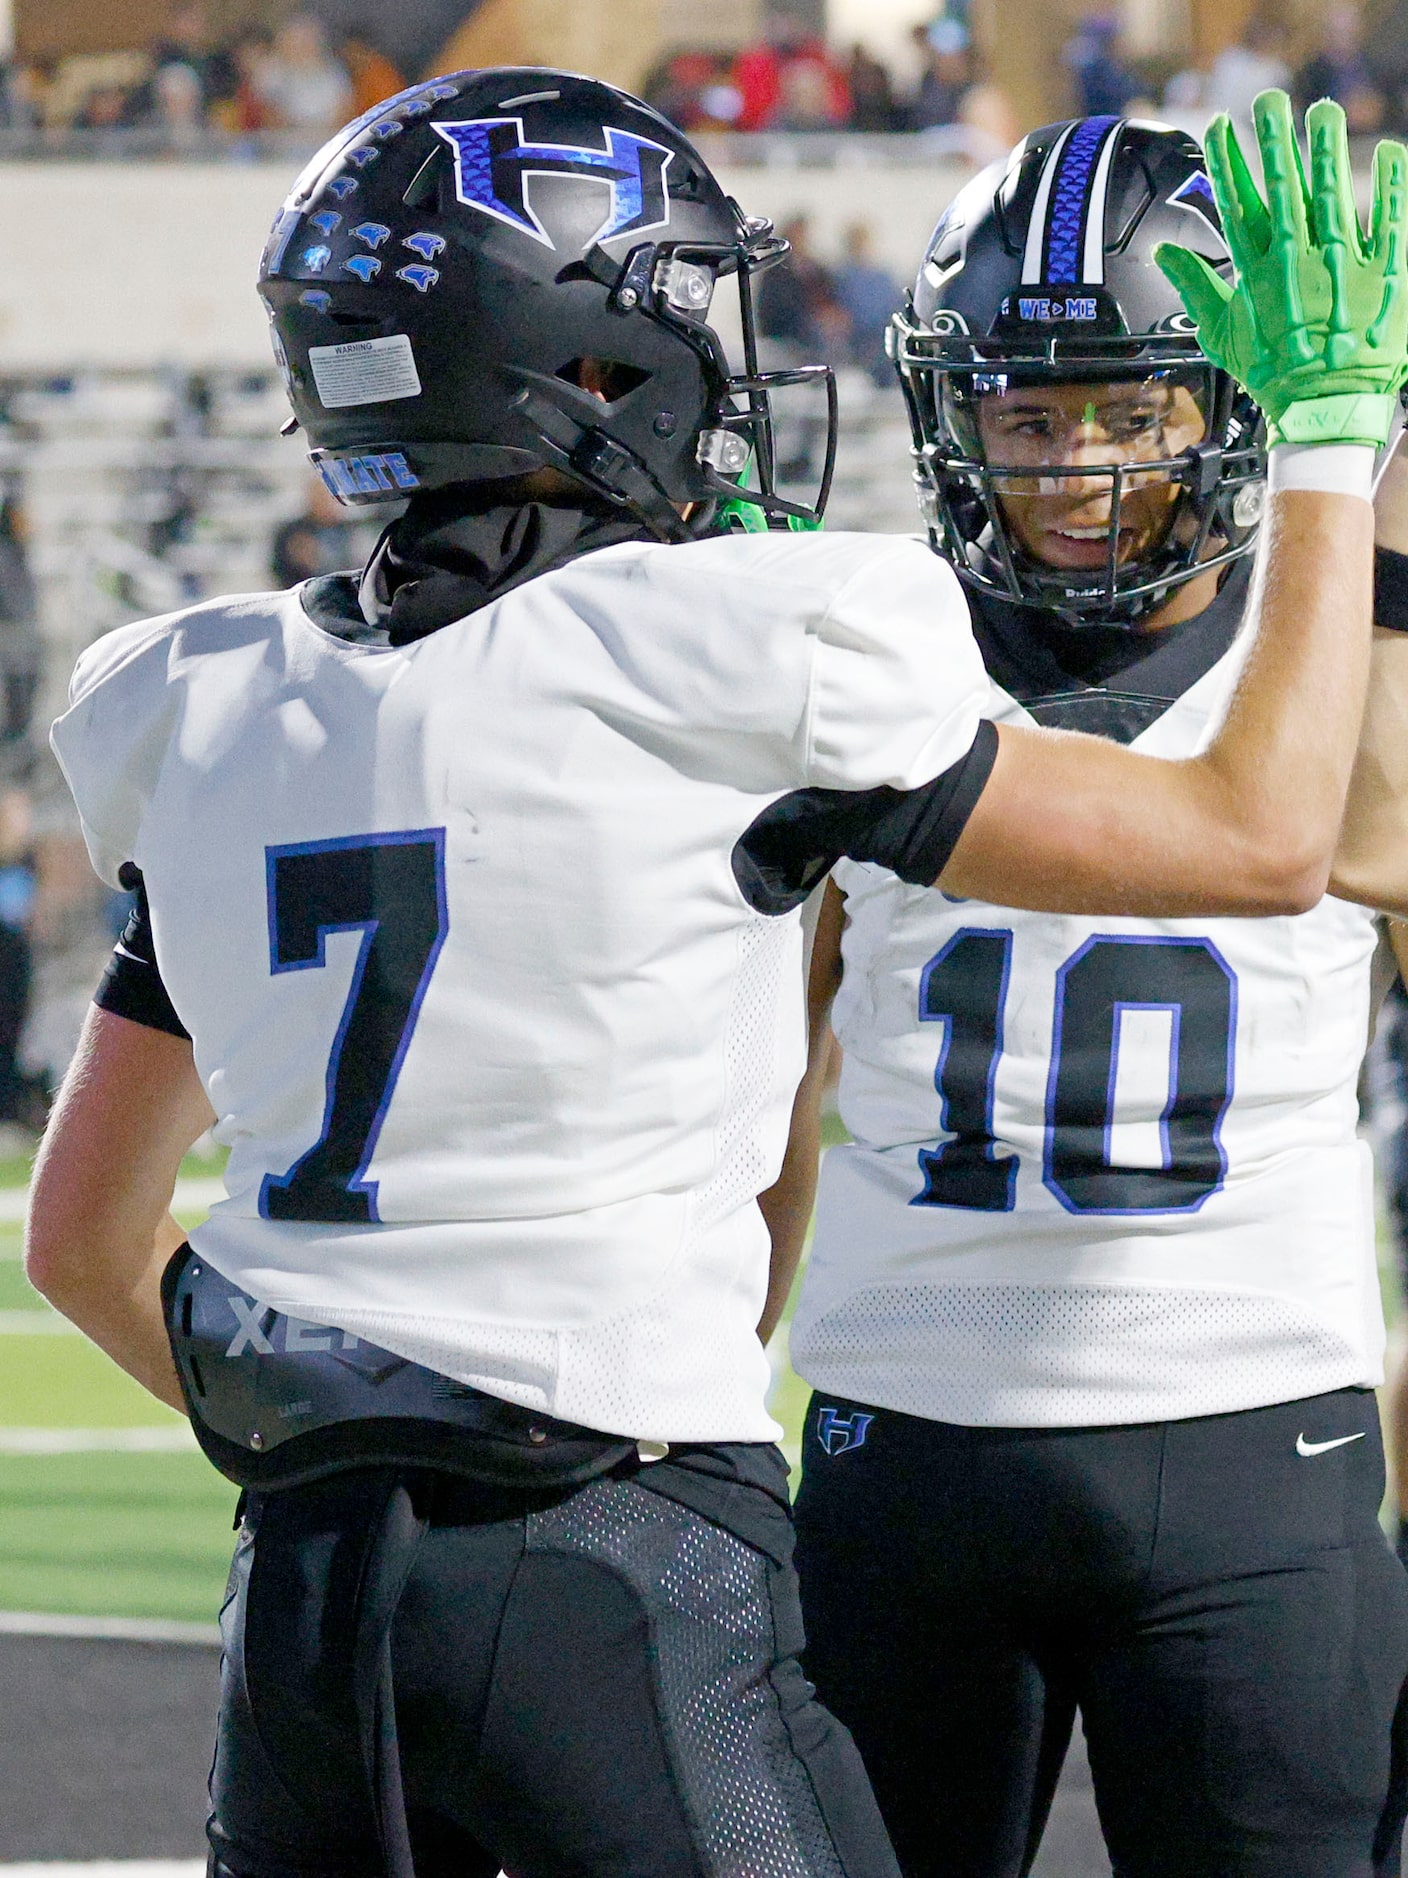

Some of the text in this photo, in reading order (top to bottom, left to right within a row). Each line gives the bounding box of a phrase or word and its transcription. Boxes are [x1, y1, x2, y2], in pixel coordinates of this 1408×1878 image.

[430, 117, 675, 250] H
[334, 342, 373, 355] WARNING
[258, 826, 449, 1224] 7
[908, 927, 1238, 1215] 10
